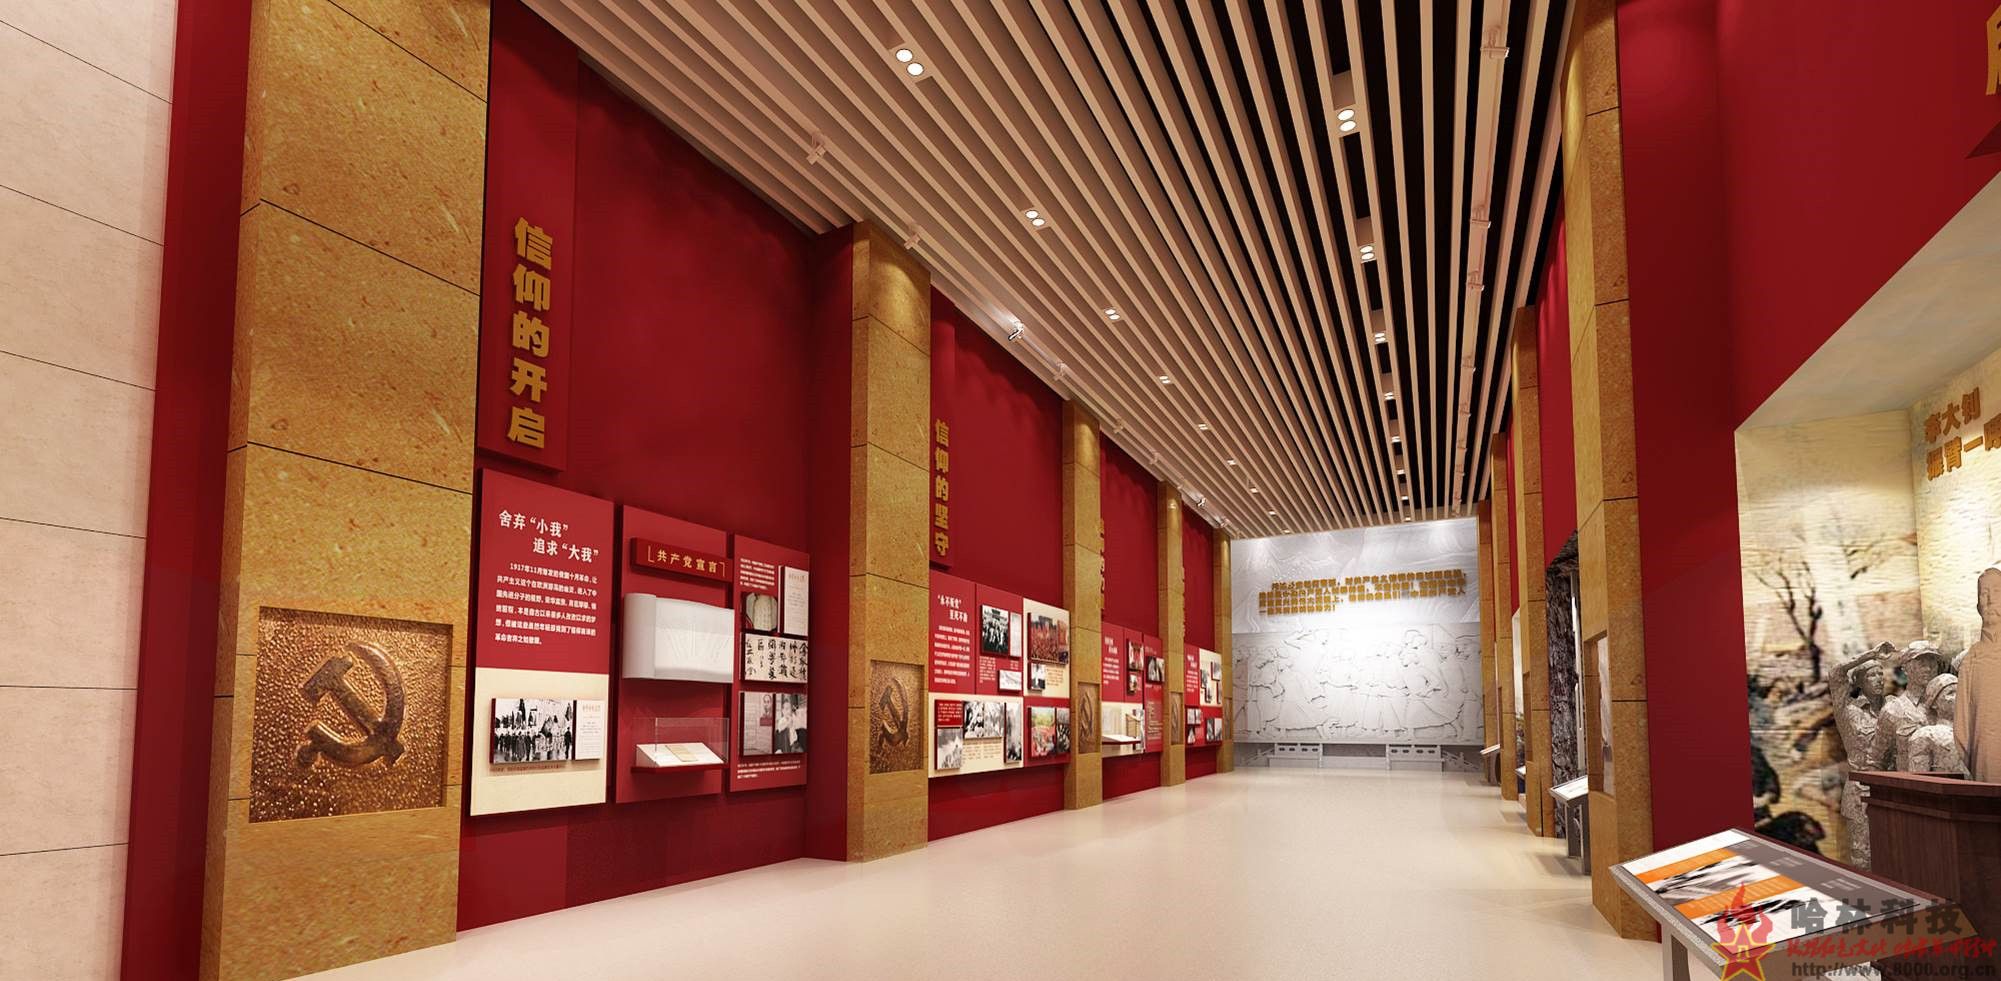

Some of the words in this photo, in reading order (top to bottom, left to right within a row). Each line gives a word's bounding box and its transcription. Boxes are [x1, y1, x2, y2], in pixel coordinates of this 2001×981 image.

[507, 217, 552, 448] 信仰的开启
[934, 419, 949, 557] 信仰的坚守
[498, 510, 569, 538] 舍弃“小我”
[532, 538, 600, 563] 追求“大我”
[657, 549, 718, 574] 共产党宣言
